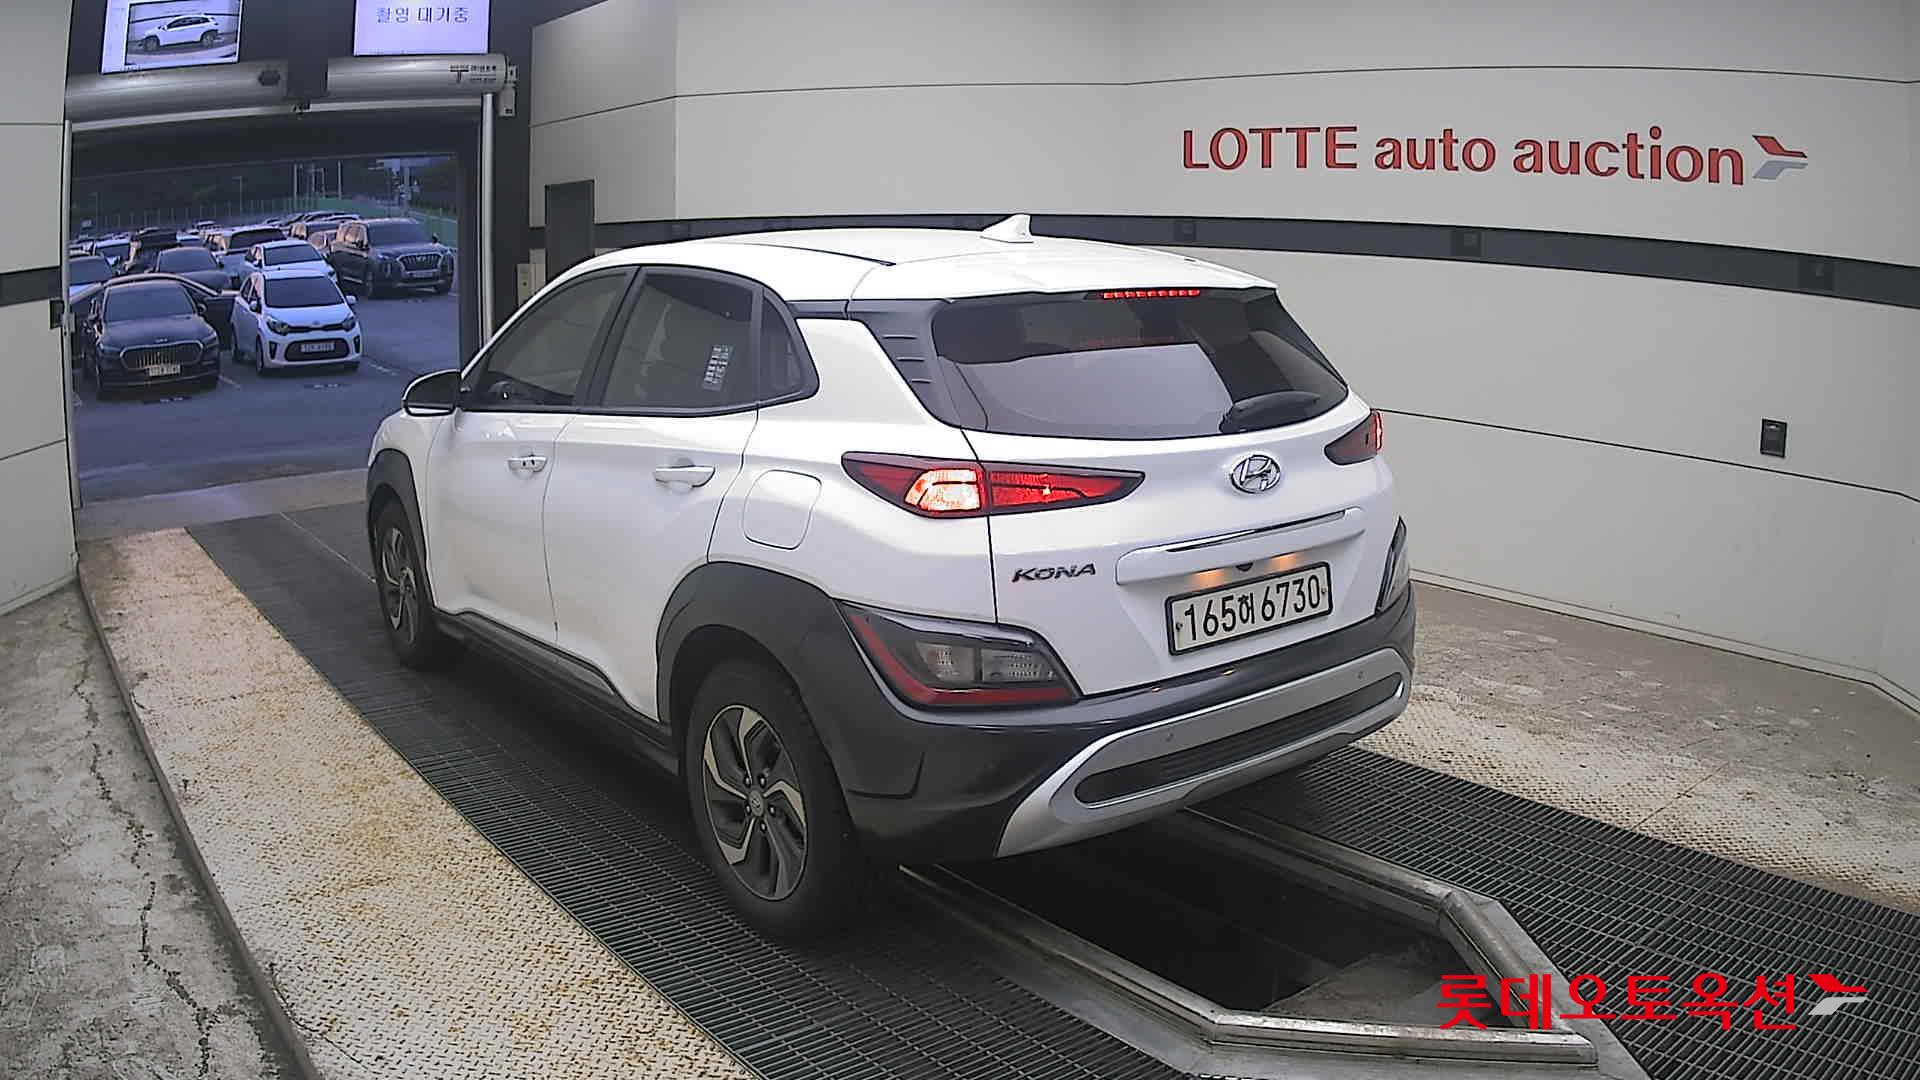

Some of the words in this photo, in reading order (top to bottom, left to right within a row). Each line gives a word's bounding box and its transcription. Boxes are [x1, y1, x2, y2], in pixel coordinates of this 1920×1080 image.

[417, 7, 468, 24] 대기중
[1183, 126, 1358, 171] LOTTE
[1374, 128, 1496, 172] auto
[1513, 126, 1745, 186] auction
[1012, 562, 1096, 583] KONA
